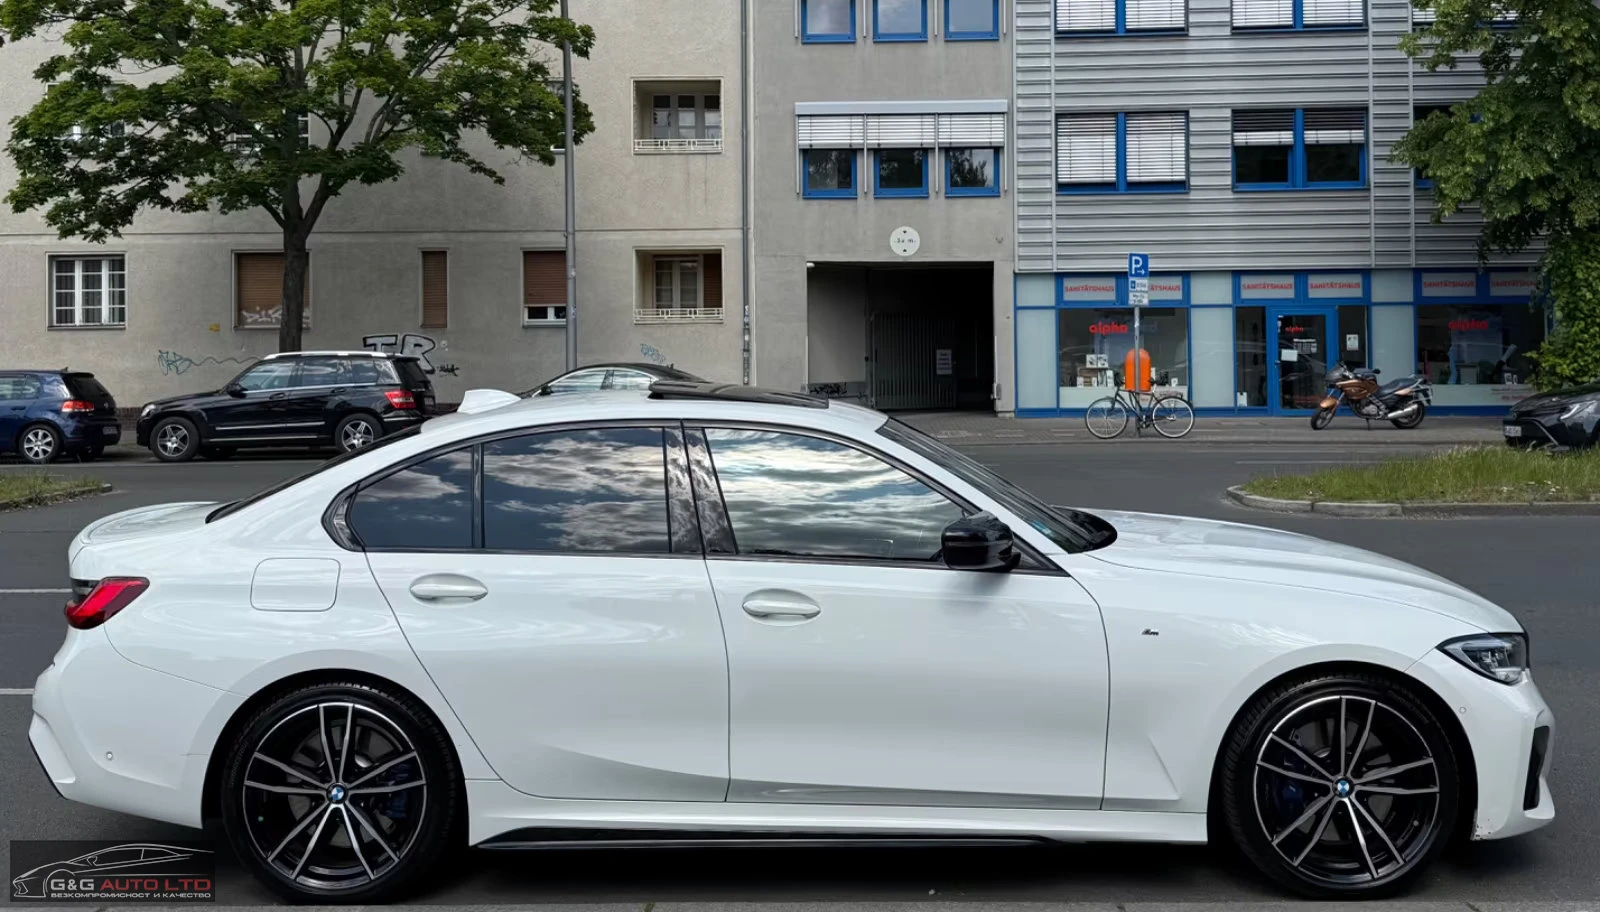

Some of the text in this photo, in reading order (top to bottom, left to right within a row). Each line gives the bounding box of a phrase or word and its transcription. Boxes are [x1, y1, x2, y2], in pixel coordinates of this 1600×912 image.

[1131, 255, 1143, 275] P
[1064, 283, 1114, 293] SANITÄTSHAUS
[1242, 282, 1293, 291] SANITÄTSHAUS
[1309, 281, 1361, 290] SANITÄTSHAUS
[1088, 322, 1128, 335] alpha
[1448, 319, 1489, 332] alpha
